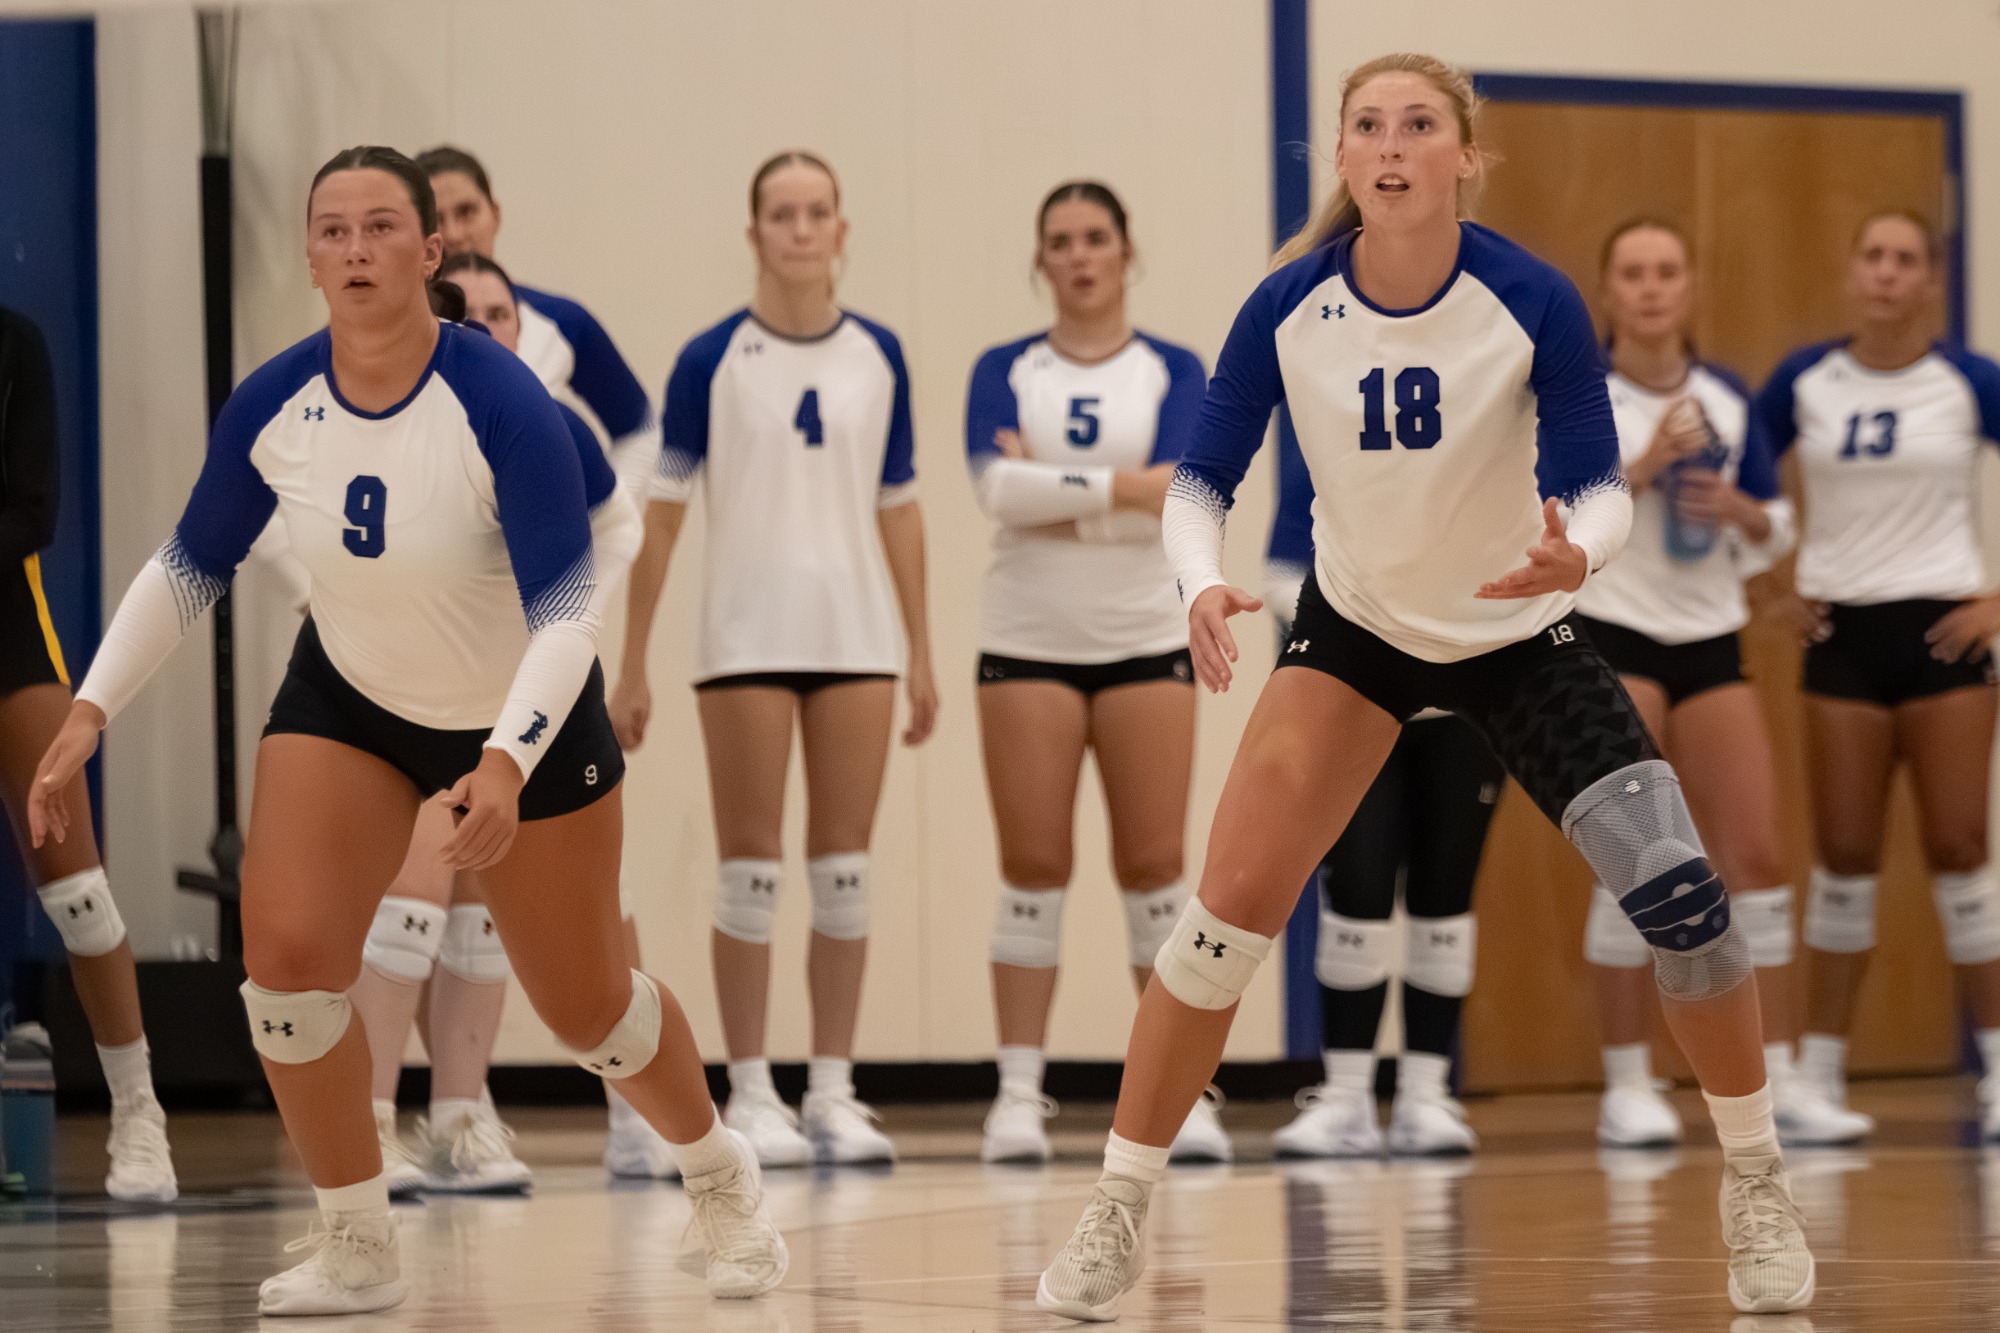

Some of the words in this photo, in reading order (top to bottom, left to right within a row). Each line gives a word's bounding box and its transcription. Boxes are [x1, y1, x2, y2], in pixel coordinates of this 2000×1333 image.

[794, 388, 823, 446] 4
[1067, 397, 1099, 448] 5
[1359, 366, 1442, 450] 18
[1839, 410, 1897, 460] 13
[342, 474, 387, 558] 9
[1548, 624, 1575, 646] 18
[585, 764, 598, 786] 9
